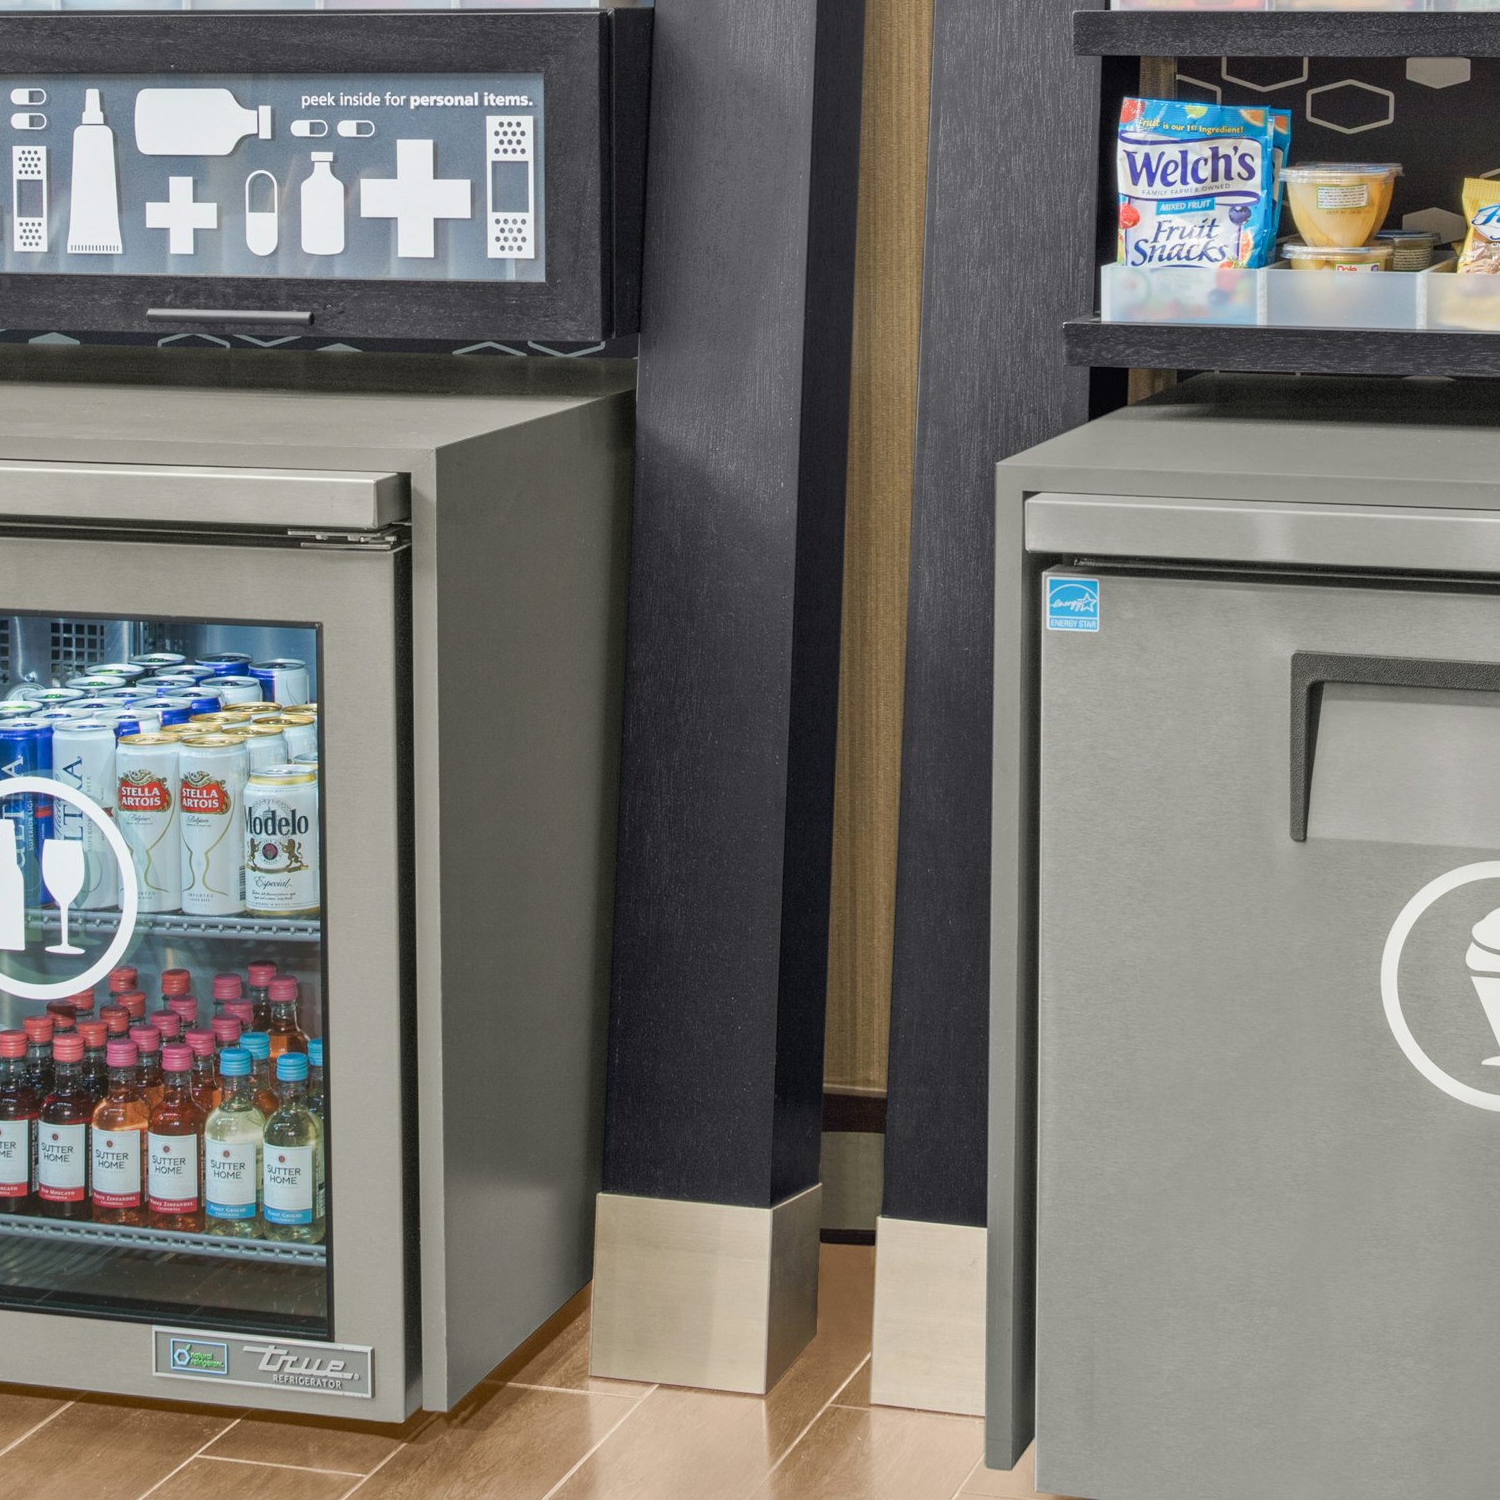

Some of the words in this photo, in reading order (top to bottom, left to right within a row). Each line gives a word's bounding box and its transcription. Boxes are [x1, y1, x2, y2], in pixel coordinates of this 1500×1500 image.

[301, 91, 336, 109] peek
[339, 91, 381, 106] inside
[384, 91, 407, 106] for
[409, 91, 479, 109] personal
[483, 91, 534, 107] items.
[1163, 122, 1169, 130] is
[1122, 145, 1256, 188] Welch's
[1141, 188, 1167, 197] FAMILY
[1170, 186, 1200, 196] FARMER
[1201, 183, 1231, 192] OWNED
[1160, 202, 1187, 212] MIXED
[1187, 200, 1211, 210] FRUIT
[1151, 217, 1221, 244] Fruit
[1130, 238, 1229, 267] Snacks
[1050, 618, 1077, 628] ENERGY
[1078, 619, 1097, 629] STAR
[121, 786, 161, 797] STELLA
[182, 788, 219, 799] STELLA
[121, 796, 161, 807] ARTOIS
[182, 798, 219, 809] ARTOIS
[41, 1141, 74, 1154] SUTTER
[43, 1152, 70, 1163] HOME
[95, 1148, 129, 1161] SUTTER
[152, 1154, 186, 1166] SUTTER
[98, 1159, 125, 1170] HOME
[154, 1164, 183, 1175] HOME
[210, 1159, 246, 1171] SUTTER
[266, 1163, 301, 1176] SUTTER
[213, 1169, 242, 1180] HOME
[269, 1174, 298, 1185] HOME
[272, 1374, 342, 1390] REFRIGERATOR
